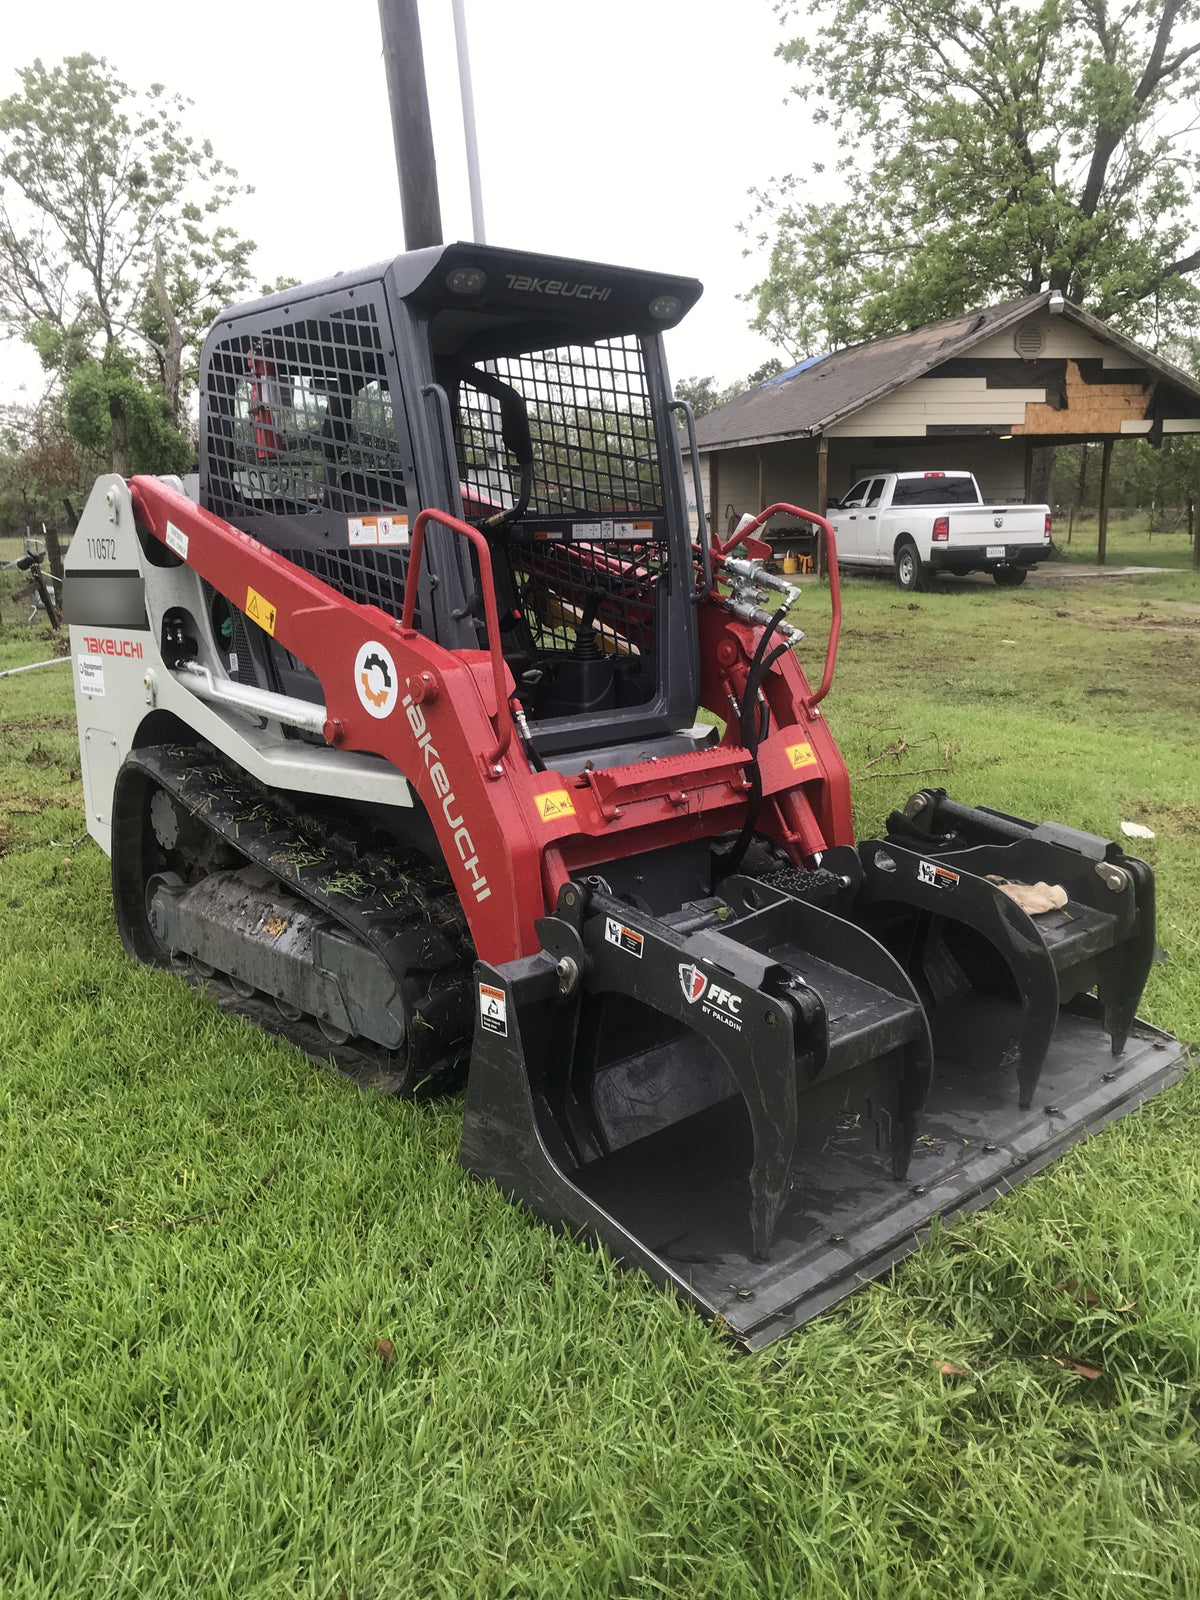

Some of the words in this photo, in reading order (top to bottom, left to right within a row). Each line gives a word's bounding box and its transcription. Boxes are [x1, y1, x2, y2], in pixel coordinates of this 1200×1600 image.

[505, 273, 612, 301] TAKEUCHI
[87, 538, 116, 560] 110572
[83, 637, 143, 660] TAKEUCHI
[707, 983, 743, 1013] FFC
[702, 1005, 711, 1014] BY
[712, 1011, 742, 1032] PALADIN
